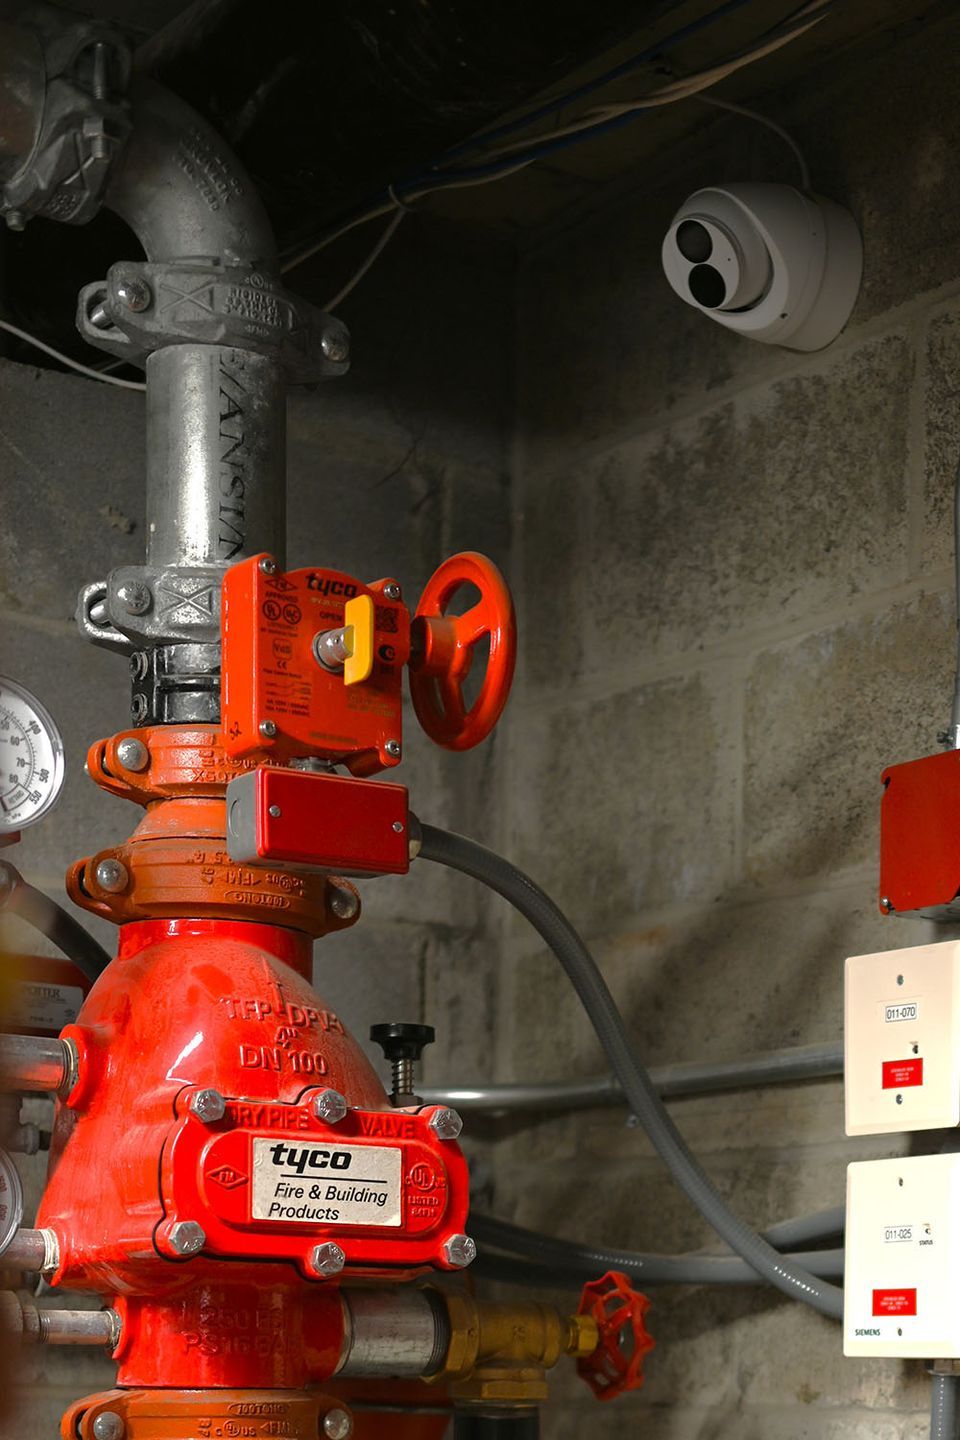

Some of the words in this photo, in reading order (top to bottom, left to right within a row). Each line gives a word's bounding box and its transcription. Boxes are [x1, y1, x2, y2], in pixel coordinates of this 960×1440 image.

[305, 572, 357, 599] tyco
[29, 720, 42, 735] 400
[10, 736, 20, 747] 60
[16, 757, 26, 768] 70
[9, 774, 19, 784] 80
[39, 768, 50, 783] 500
[30, 790, 43, 805] 550
[886, 1006, 916, 1020] 011-070
[240, 1045, 281, 1072] DN
[287, 1050, 328, 1075] 100
[267, 1106, 309, 1130] PIPE
[359, 1114, 416, 1137] VALVE
[269, 1143, 353, 1174] tyco
[274, 1182, 305, 1199] Fire
[308, 1184, 322, 1201] &
[324, 1185, 388, 1207] Building
[268, 1203, 340, 1221] Products
[885, 1228, 912, 1240] 011-025
[855, 1328, 881, 1337] SIEMENS
